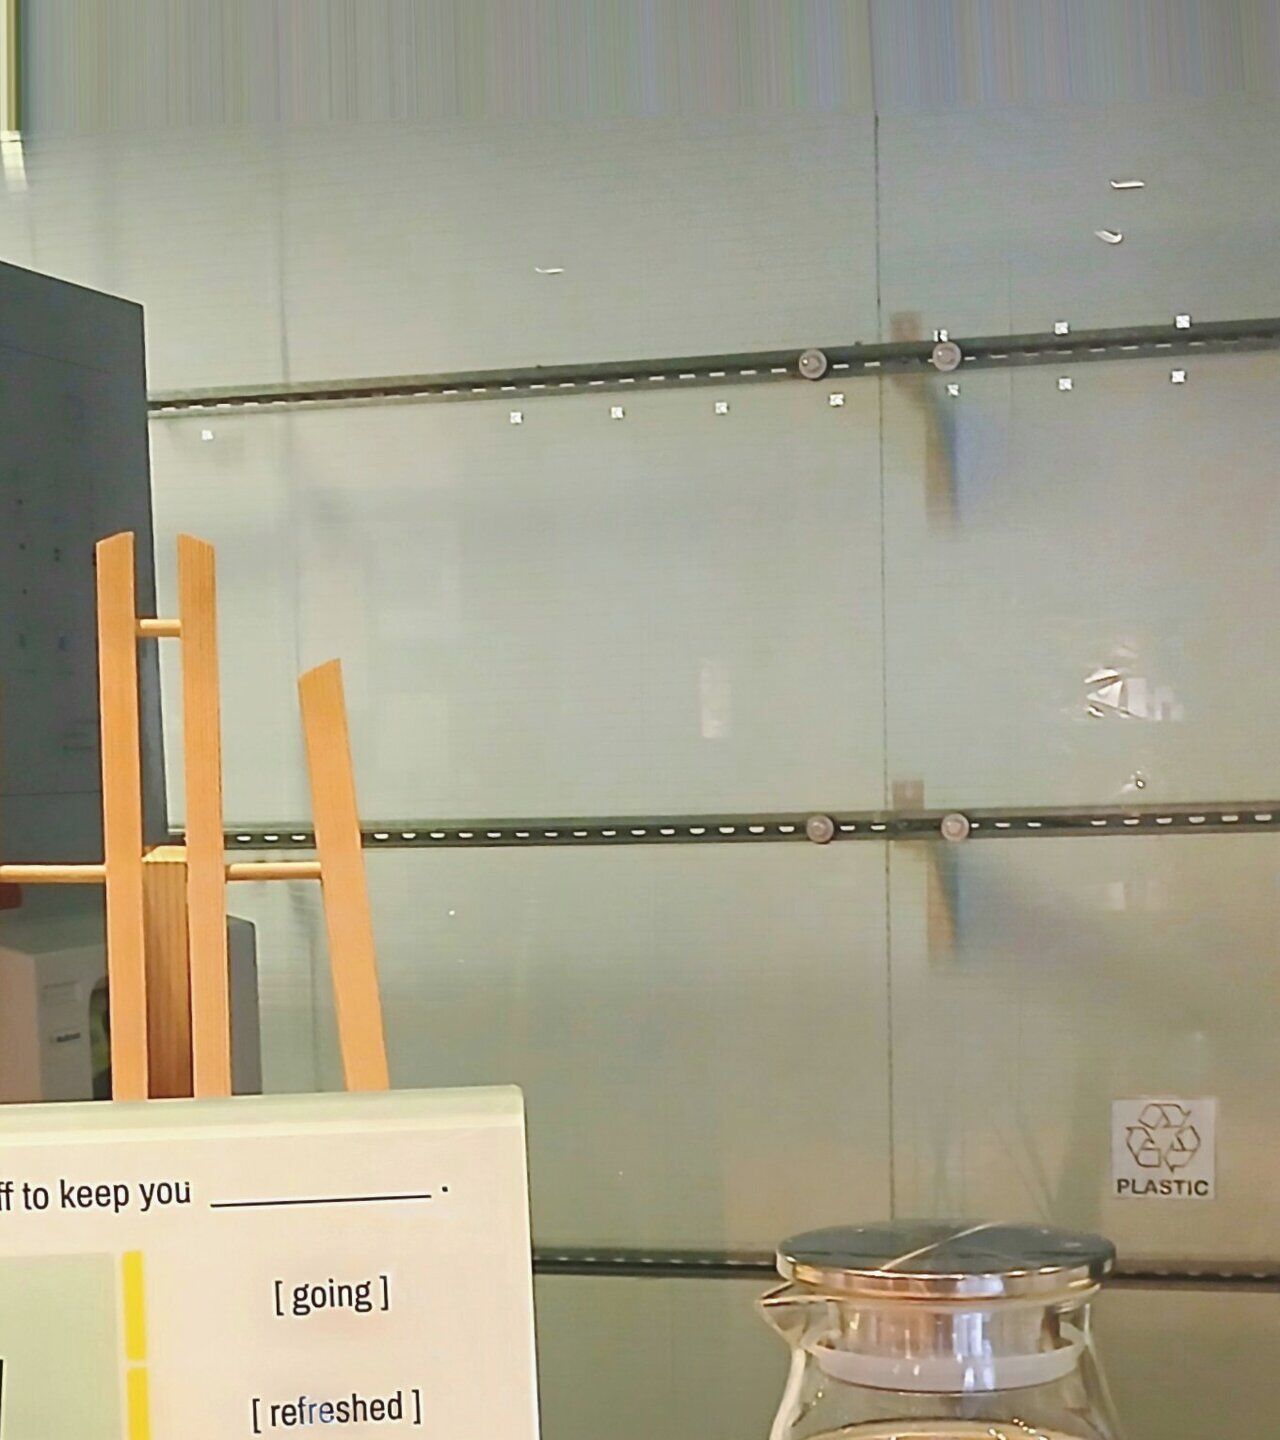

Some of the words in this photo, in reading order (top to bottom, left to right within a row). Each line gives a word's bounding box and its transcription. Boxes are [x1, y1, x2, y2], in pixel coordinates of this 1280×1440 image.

[22, 1182, 51, 1211] to
[60, 1178, 130, 1214] keep
[139, 1182, 191, 1213] you
[1117, 1178, 1209, 1196] PLASTIC
